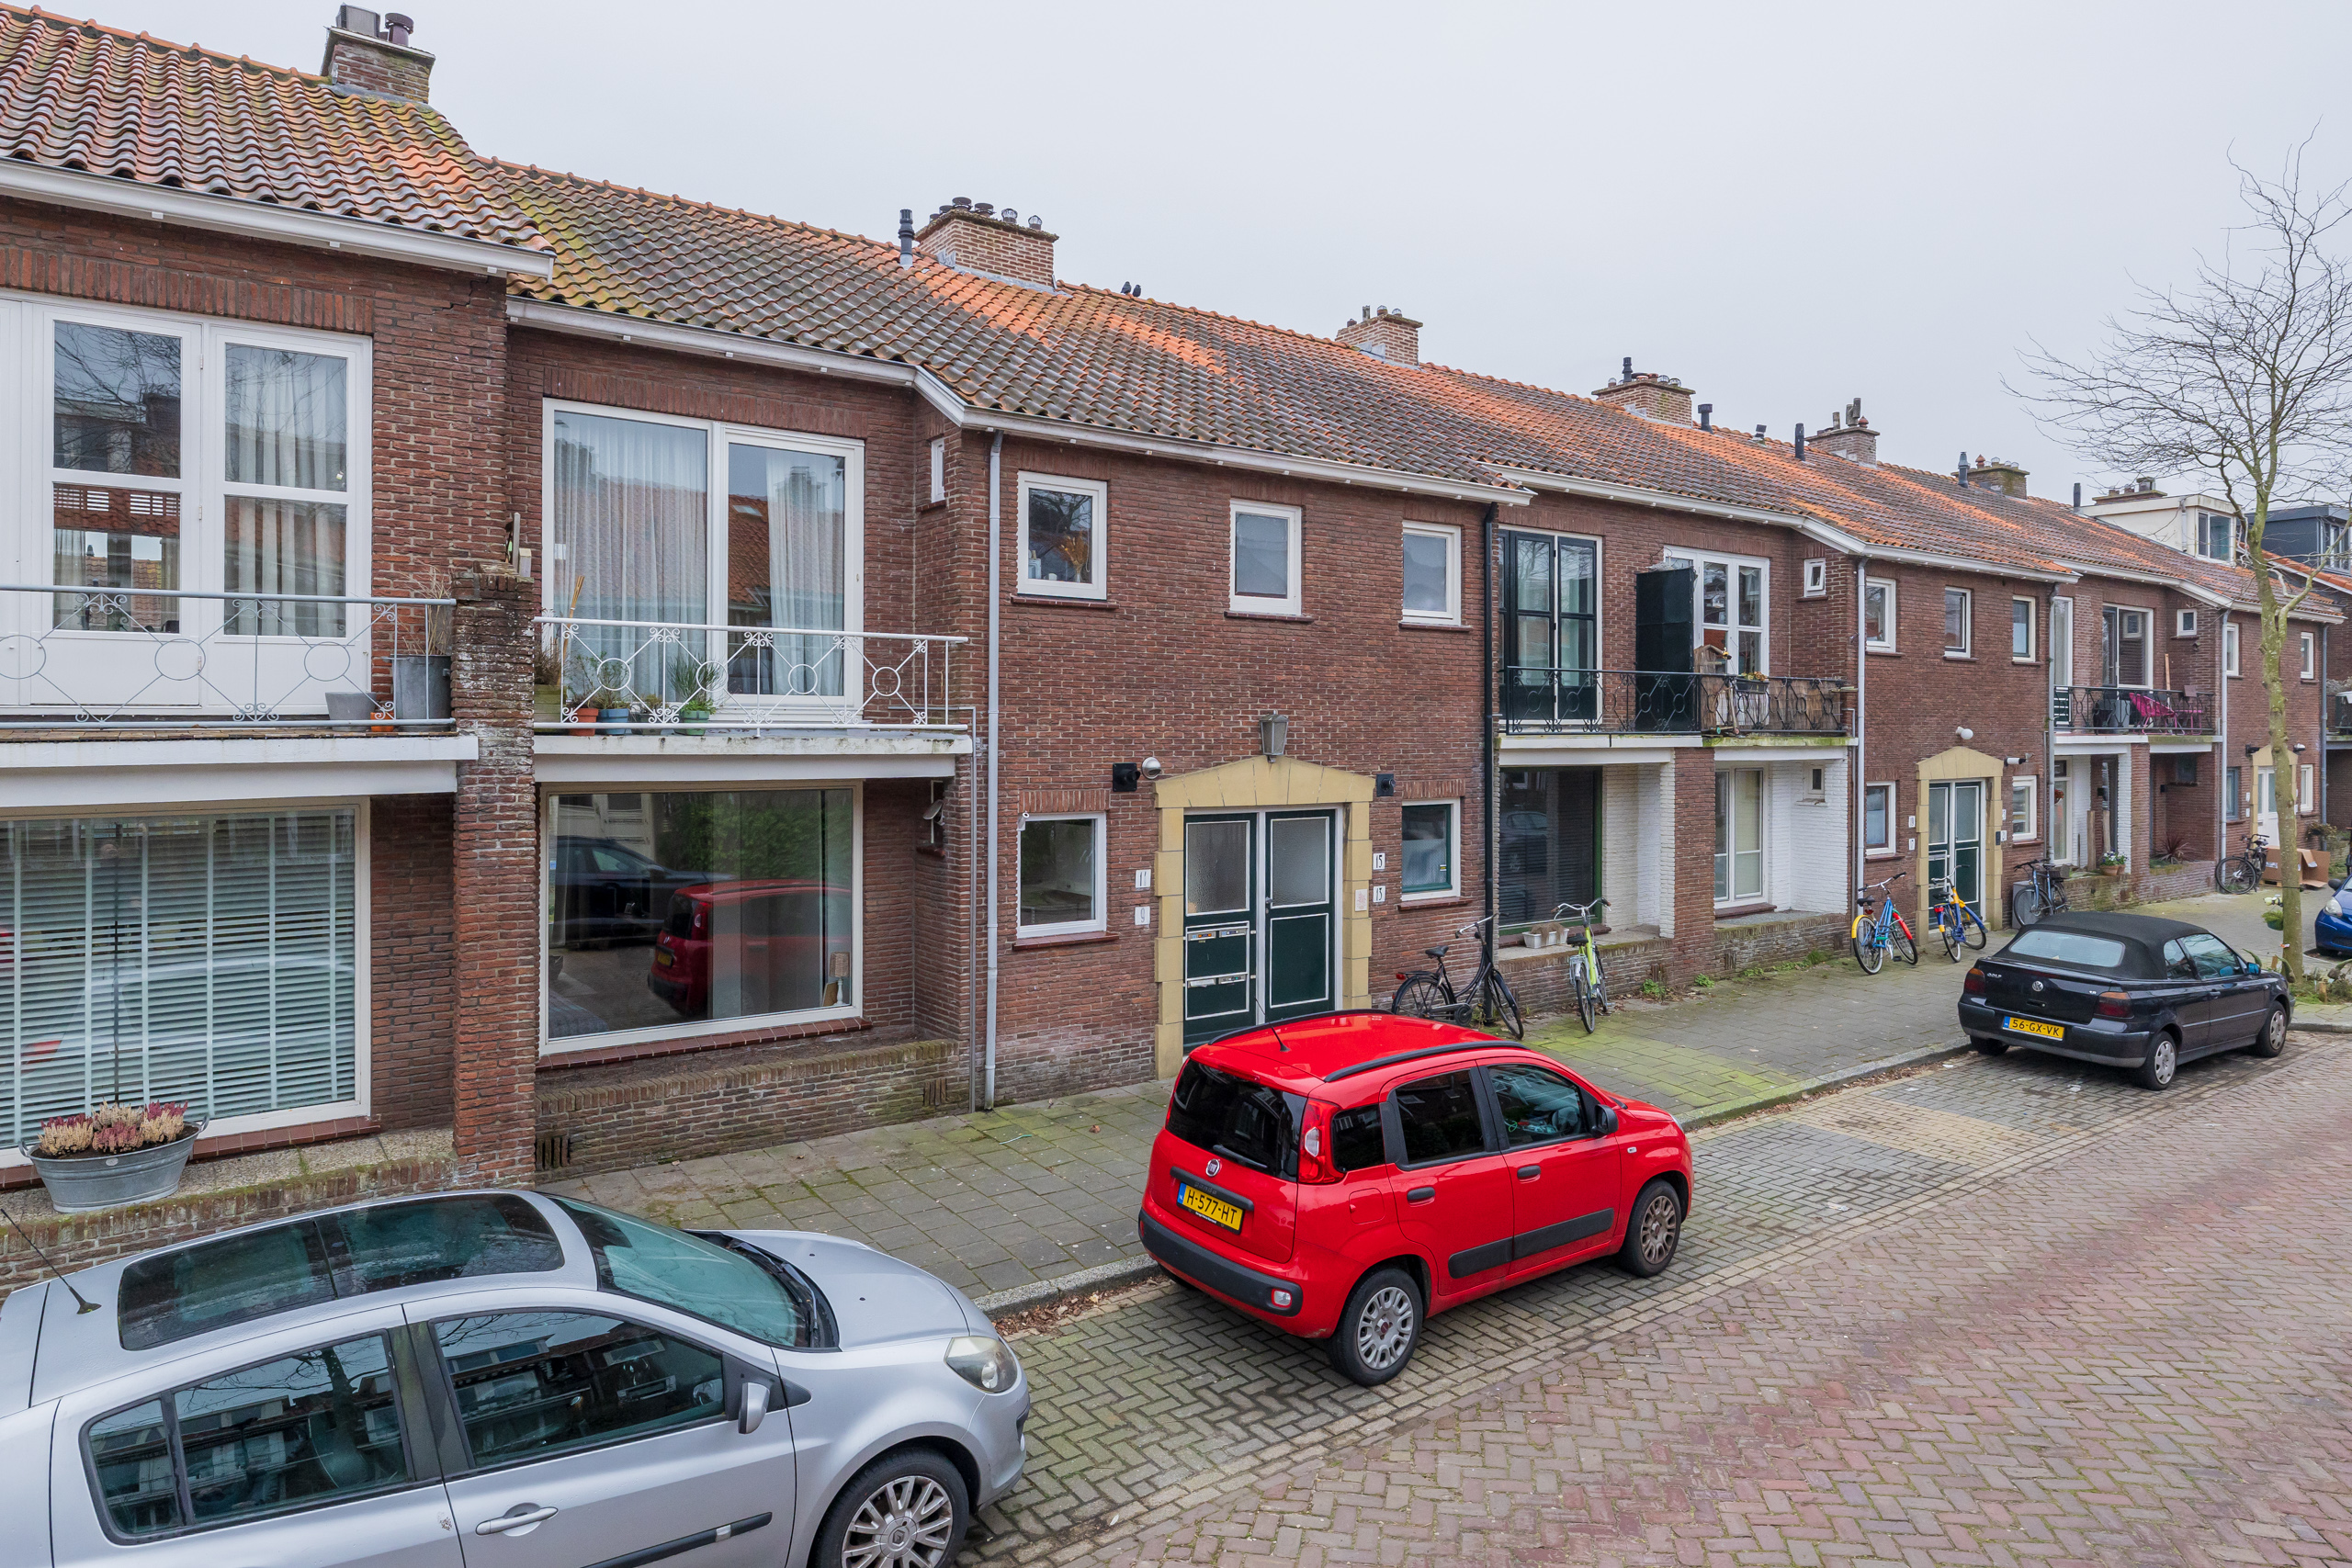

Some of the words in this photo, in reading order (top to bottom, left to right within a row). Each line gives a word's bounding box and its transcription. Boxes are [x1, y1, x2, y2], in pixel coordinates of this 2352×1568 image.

[1375, 854, 1383, 869] 15
[1375, 887, 1383, 901] 13
[1140, 907, 1146, 923] 9
[2012, 1019, 2060, 1037] 56-GX-VK
[1186, 1189, 1238, 1224] H-577-HT
